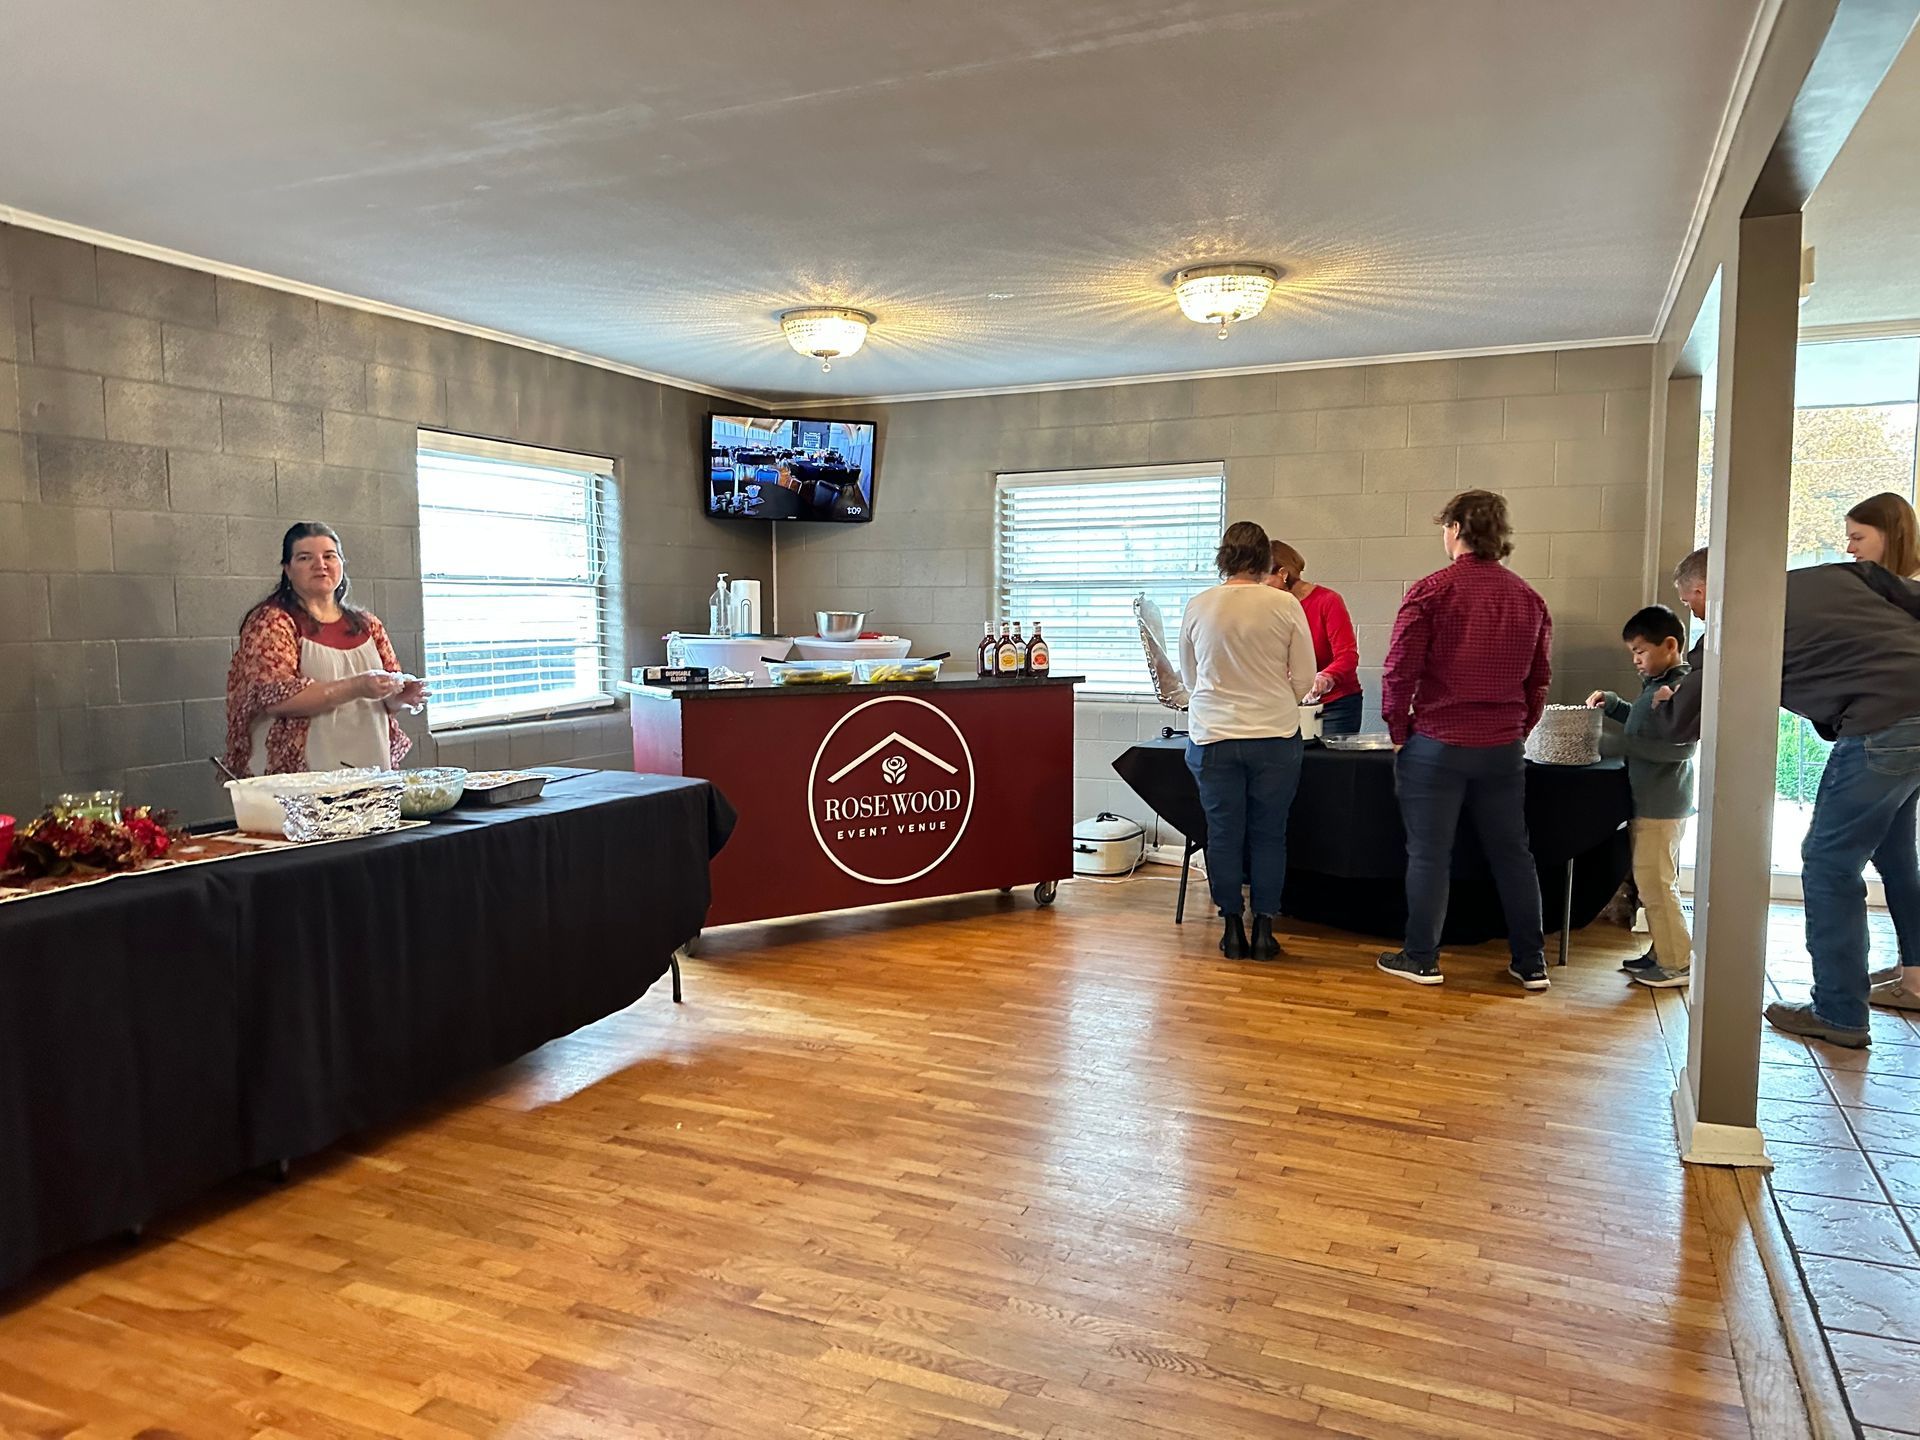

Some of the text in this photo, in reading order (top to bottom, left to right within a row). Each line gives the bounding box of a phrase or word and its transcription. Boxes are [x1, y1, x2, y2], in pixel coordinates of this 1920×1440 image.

[824, 789, 961, 821] ROSEWOOD
[837, 821, 947, 840] EVENT VENUE
